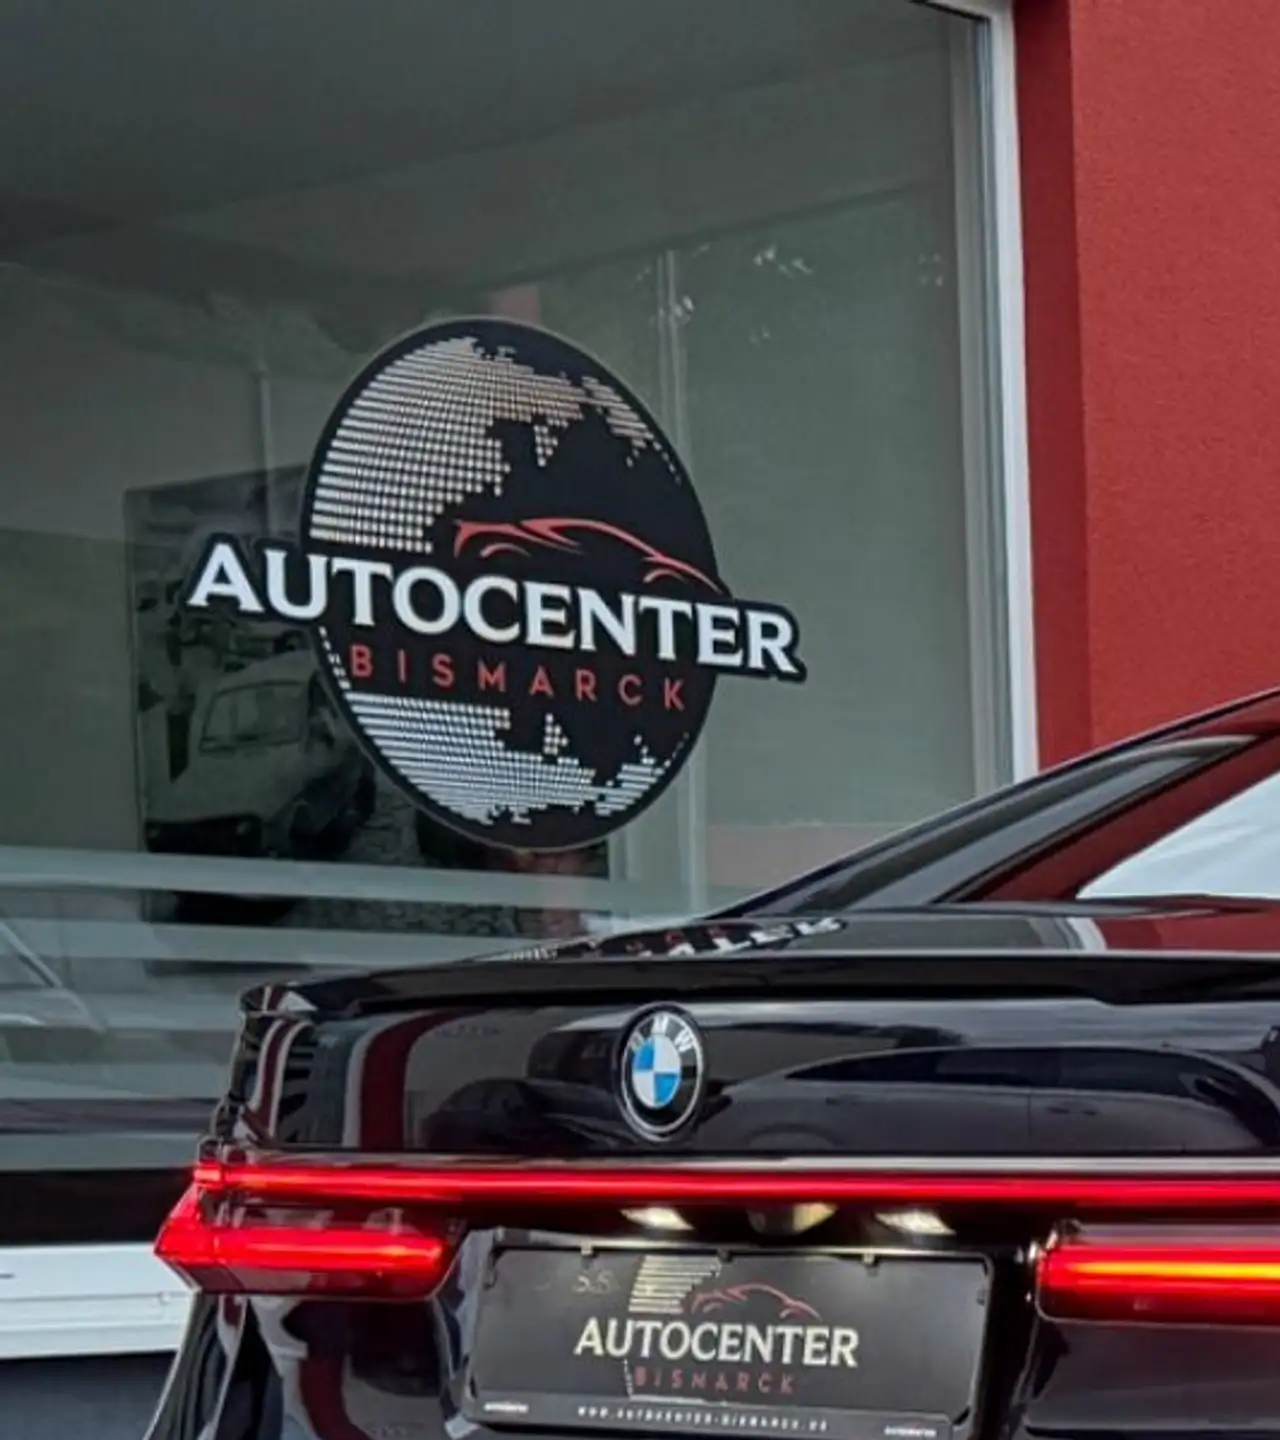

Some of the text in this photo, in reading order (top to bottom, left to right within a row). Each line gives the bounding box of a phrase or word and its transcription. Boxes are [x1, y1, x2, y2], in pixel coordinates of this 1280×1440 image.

[188, 541, 797, 674] AUTOCENTER
[350, 643, 685, 710] BISMARCK
[629, 1012, 695, 1053] BMW
[573, 1316, 859, 1369] AUTOCENTER
[633, 1365, 796, 1395] BISMARCK
